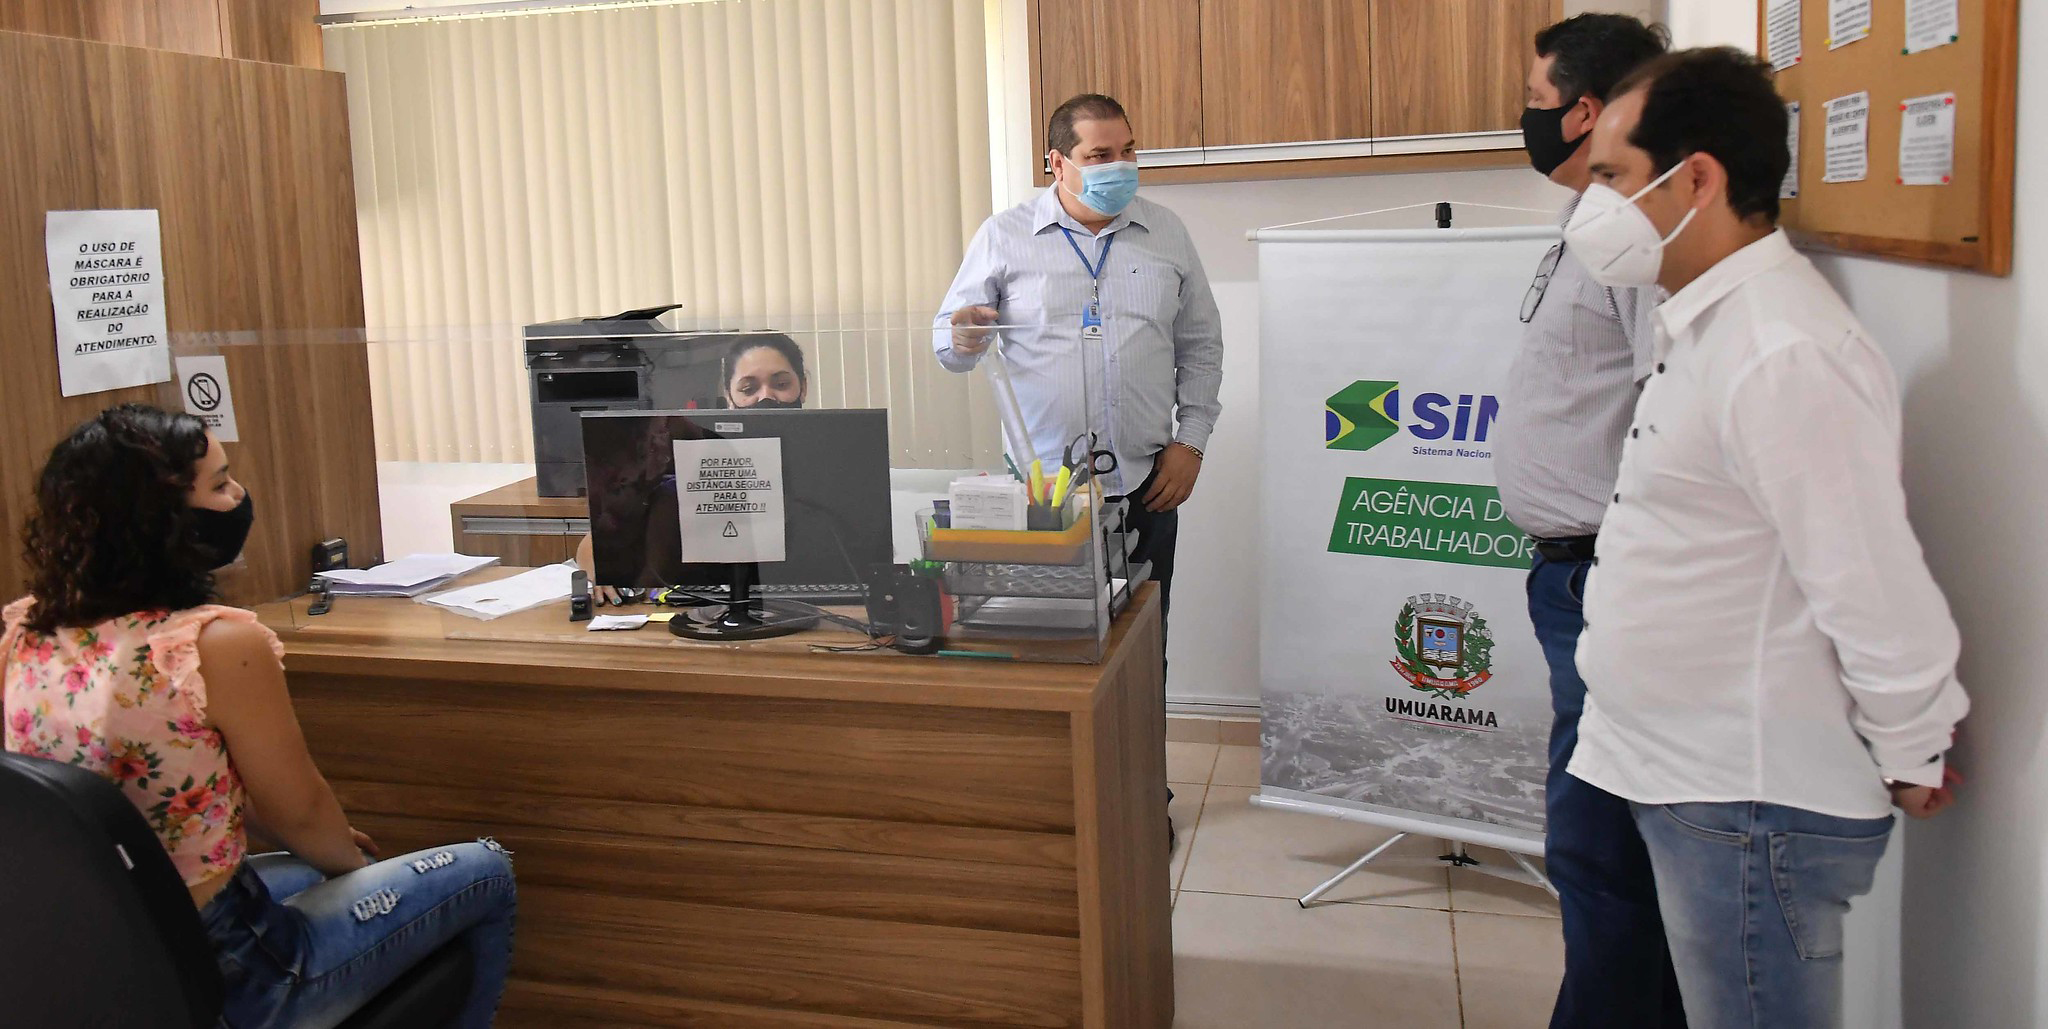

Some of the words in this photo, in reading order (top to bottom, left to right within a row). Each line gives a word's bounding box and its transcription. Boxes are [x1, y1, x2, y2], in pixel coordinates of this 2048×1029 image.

[80, 244, 88, 253] O
[92, 242, 116, 252] USO
[120, 242, 135, 251] DE
[74, 257, 132, 270] MÁSCARA
[70, 272, 150, 287] OBRIGATÓRIO
[92, 291, 122, 302] PARA
[126, 290, 133, 299] A
[77, 303, 149, 320] REALIZAÇÃO
[107, 322, 123, 333] DO
[75, 335, 157, 353] ATENDIMENTO.
[1412, 446, 1453, 457] Sistema
[701, 458, 719, 467] POR
[700, 469, 736, 479] MANTER
[738, 469, 757, 478] UMA
[686, 479, 733, 490] DISTÂNCIA
[735, 480, 771, 489] SEGURA
[713, 492, 738, 501] PARA
[740, 492, 747, 500] O
[695, 503, 758, 512] ATENDIMENTO
[1352, 485, 1475, 521] AGÊNCIA
[1484, 499, 1513, 523] D
[1346, 522, 1536, 560] TRABALHADOR
[1385, 696, 1498, 728] UMUARAMA
